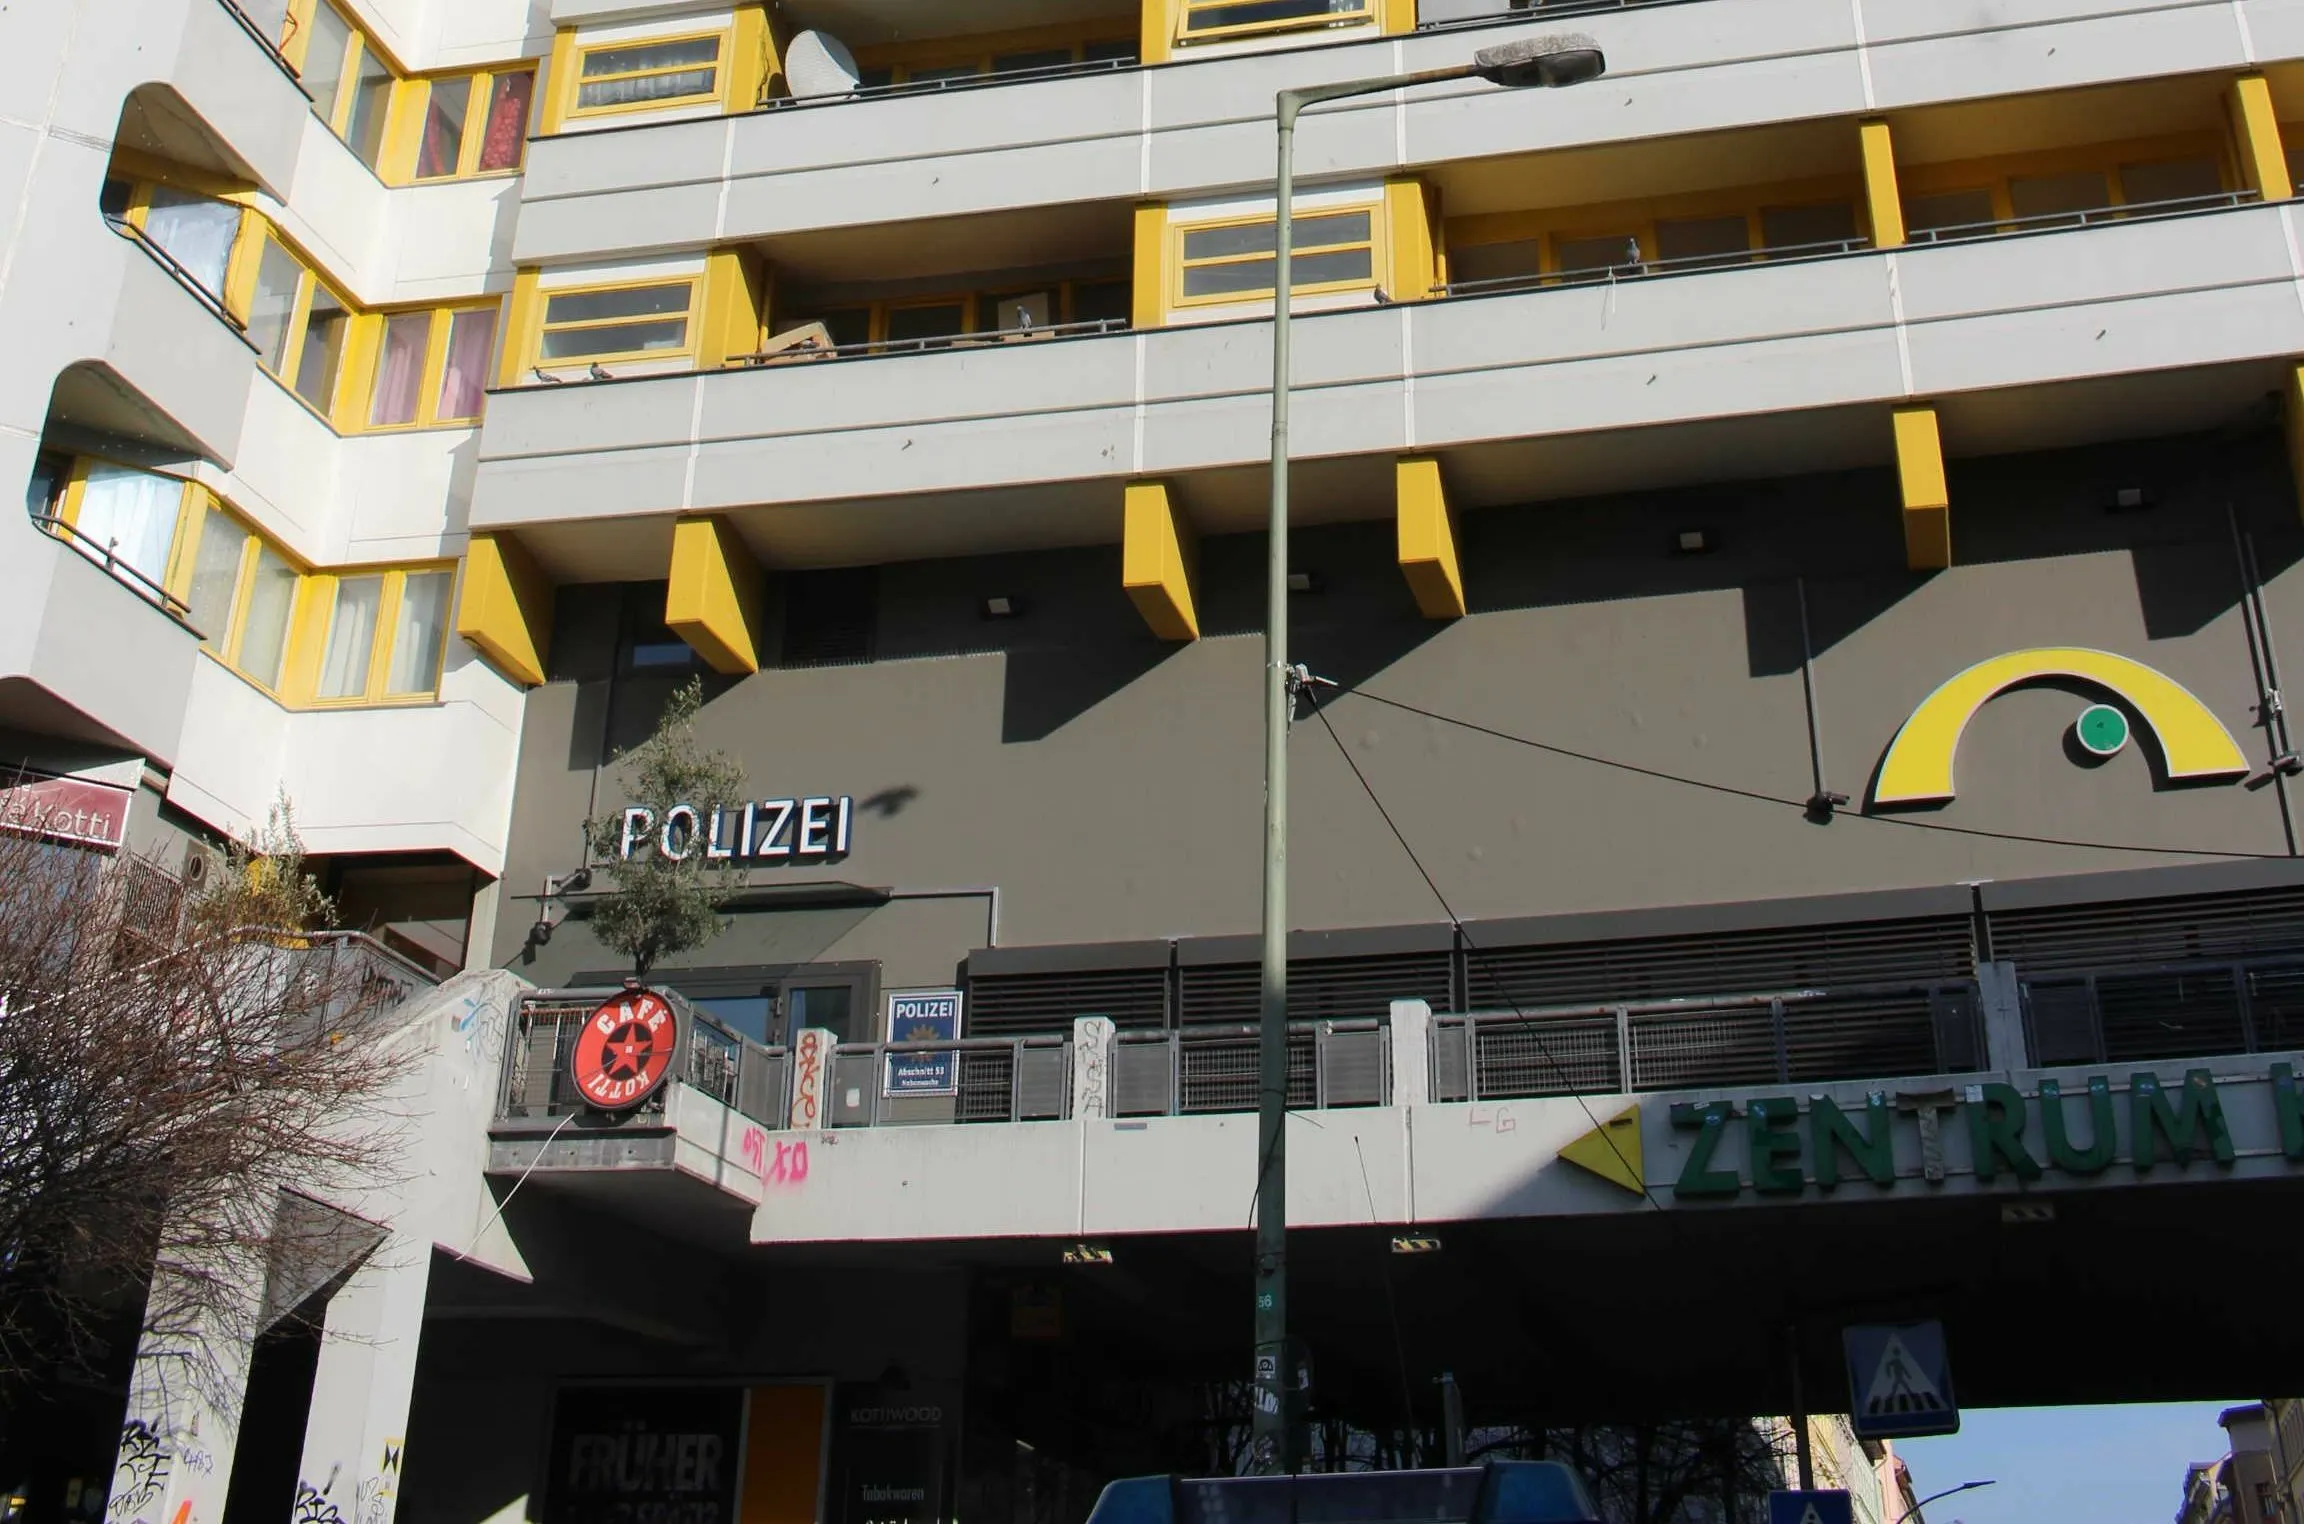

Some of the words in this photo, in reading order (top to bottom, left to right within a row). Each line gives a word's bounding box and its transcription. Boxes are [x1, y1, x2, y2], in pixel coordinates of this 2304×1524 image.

[33, 800, 111, 839] Kotti
[620, 796, 852, 861] POLIZEI
[896, 1002, 953, 1018] POLIZEI
[588, 1071, 650, 1099] KOTTI
[1670, 1067, 2236, 1198] ZENTRUM
[568, 1420, 724, 1492] FRÜHER
